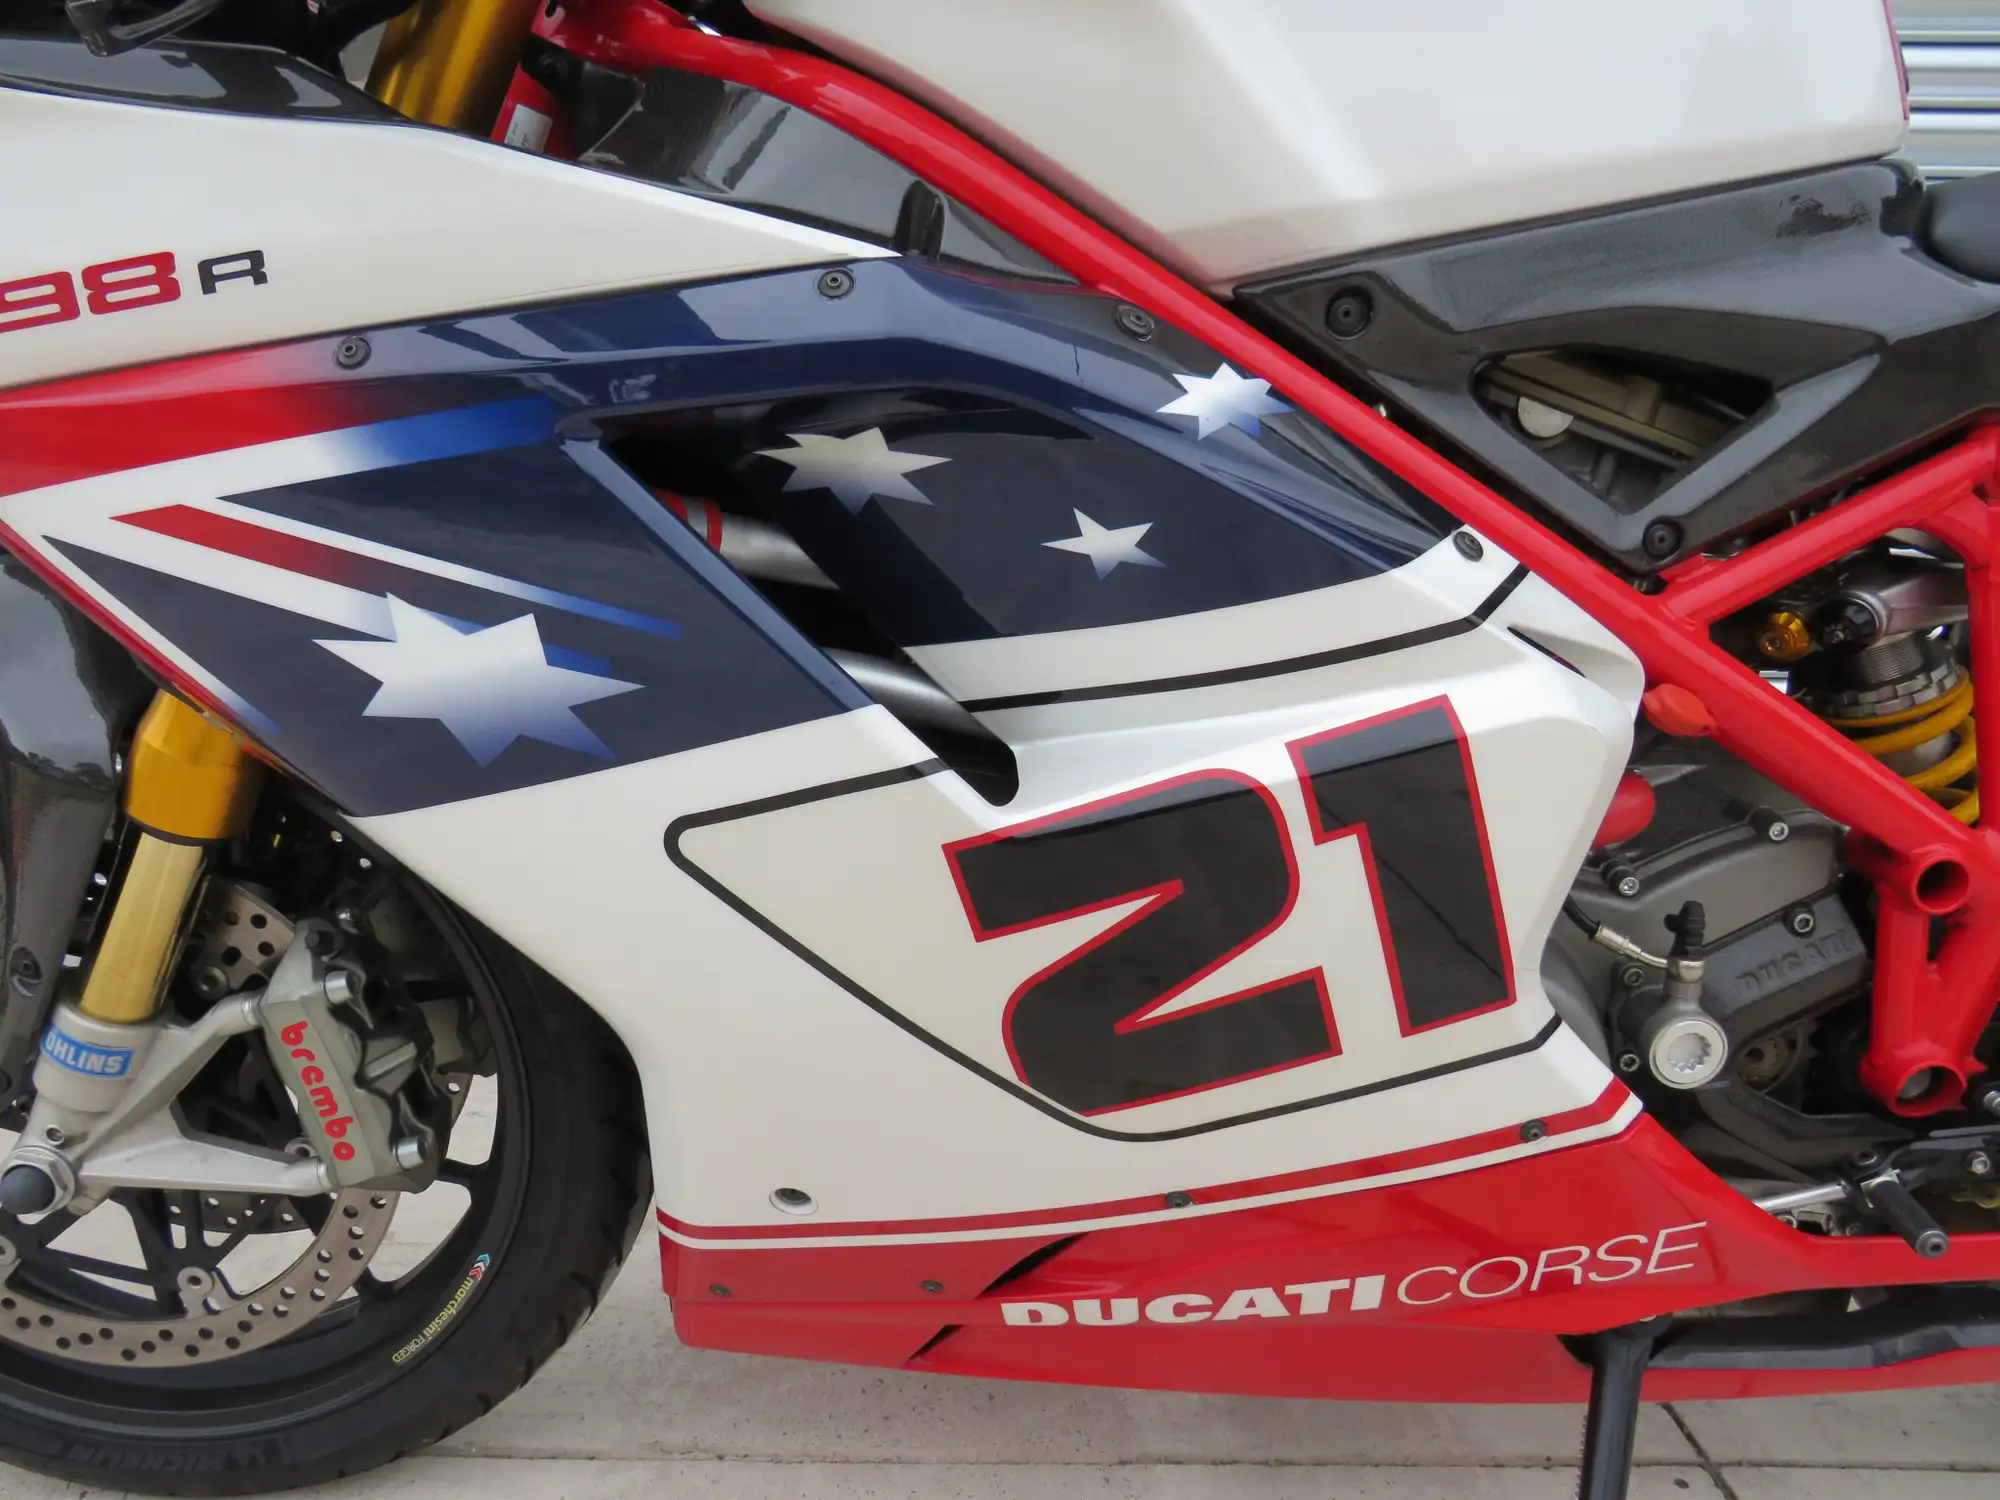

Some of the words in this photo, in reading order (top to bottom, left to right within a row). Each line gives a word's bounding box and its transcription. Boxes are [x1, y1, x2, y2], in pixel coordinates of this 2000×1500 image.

[0, 251, 181, 333] 98
[197, 250, 268, 295] R
[941, 694, 1517, 1118] 21
[280, 1020, 356, 1161] brembo
[422, 1276, 474, 1340] marchesini
[1001, 1274, 1386, 1326] DUCATI
[1397, 1222, 1707, 1305] CORSE
[391, 1334, 426, 1363] FORGED
